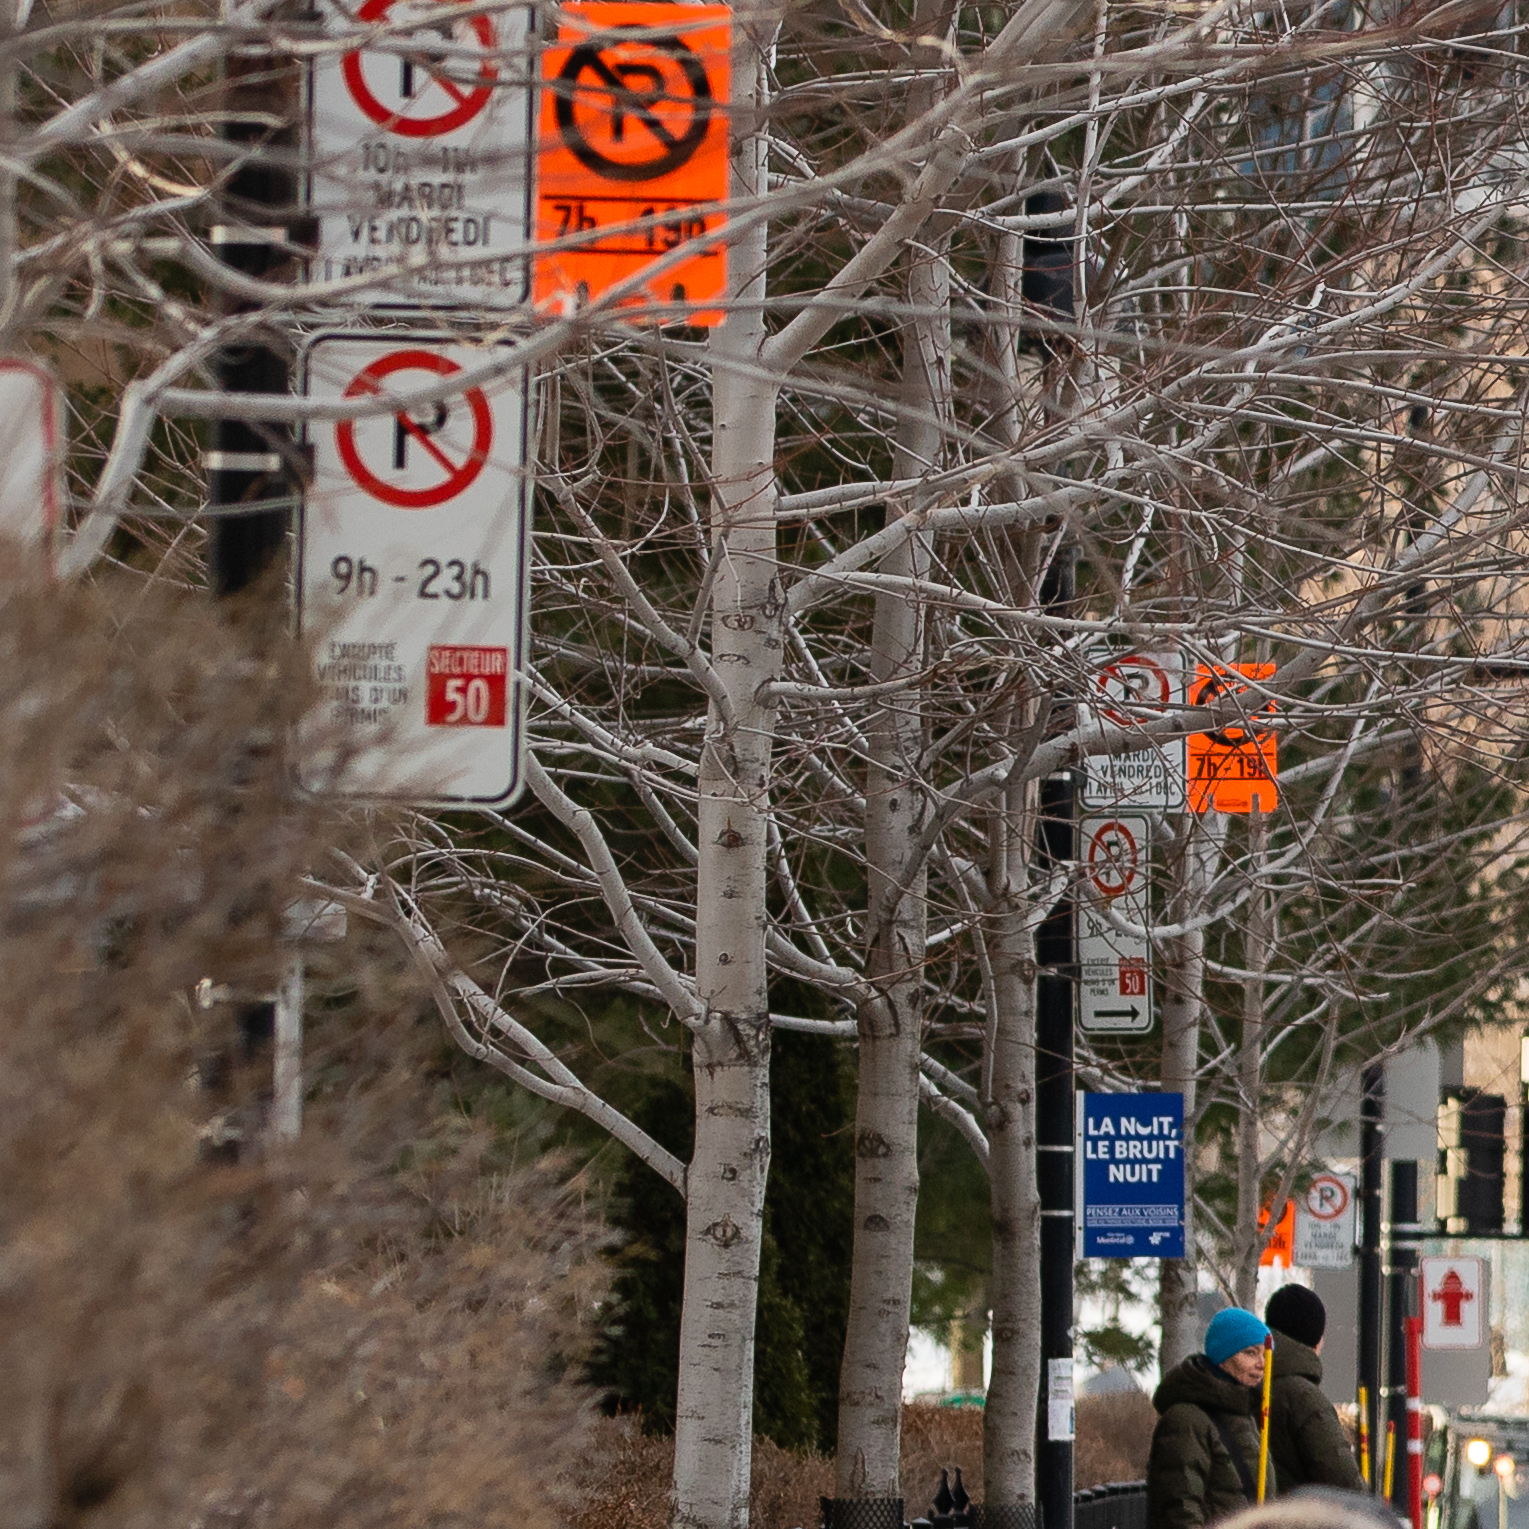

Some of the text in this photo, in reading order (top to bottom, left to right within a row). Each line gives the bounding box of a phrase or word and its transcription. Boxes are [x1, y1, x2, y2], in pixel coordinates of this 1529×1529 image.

[554, 203, 598, 241] 7h
[331, 555, 377, 597] 9h
[418, 557, 491, 600] 23h
[430, 650, 505, 675] SECTEUR
[444, 677, 491, 723] 50
[1196, 756, 1218, 778] 7h
[1125, 972, 1140, 994] 50
[1087, 1116, 1178, 1139] LA NUIT,
[1086, 1140, 1180, 1160] LE BRUIT
[1108, 1163, 1162, 1183] NUIT
[1086, 1207, 1179, 1217] PENSEZ AUX VOISINS
